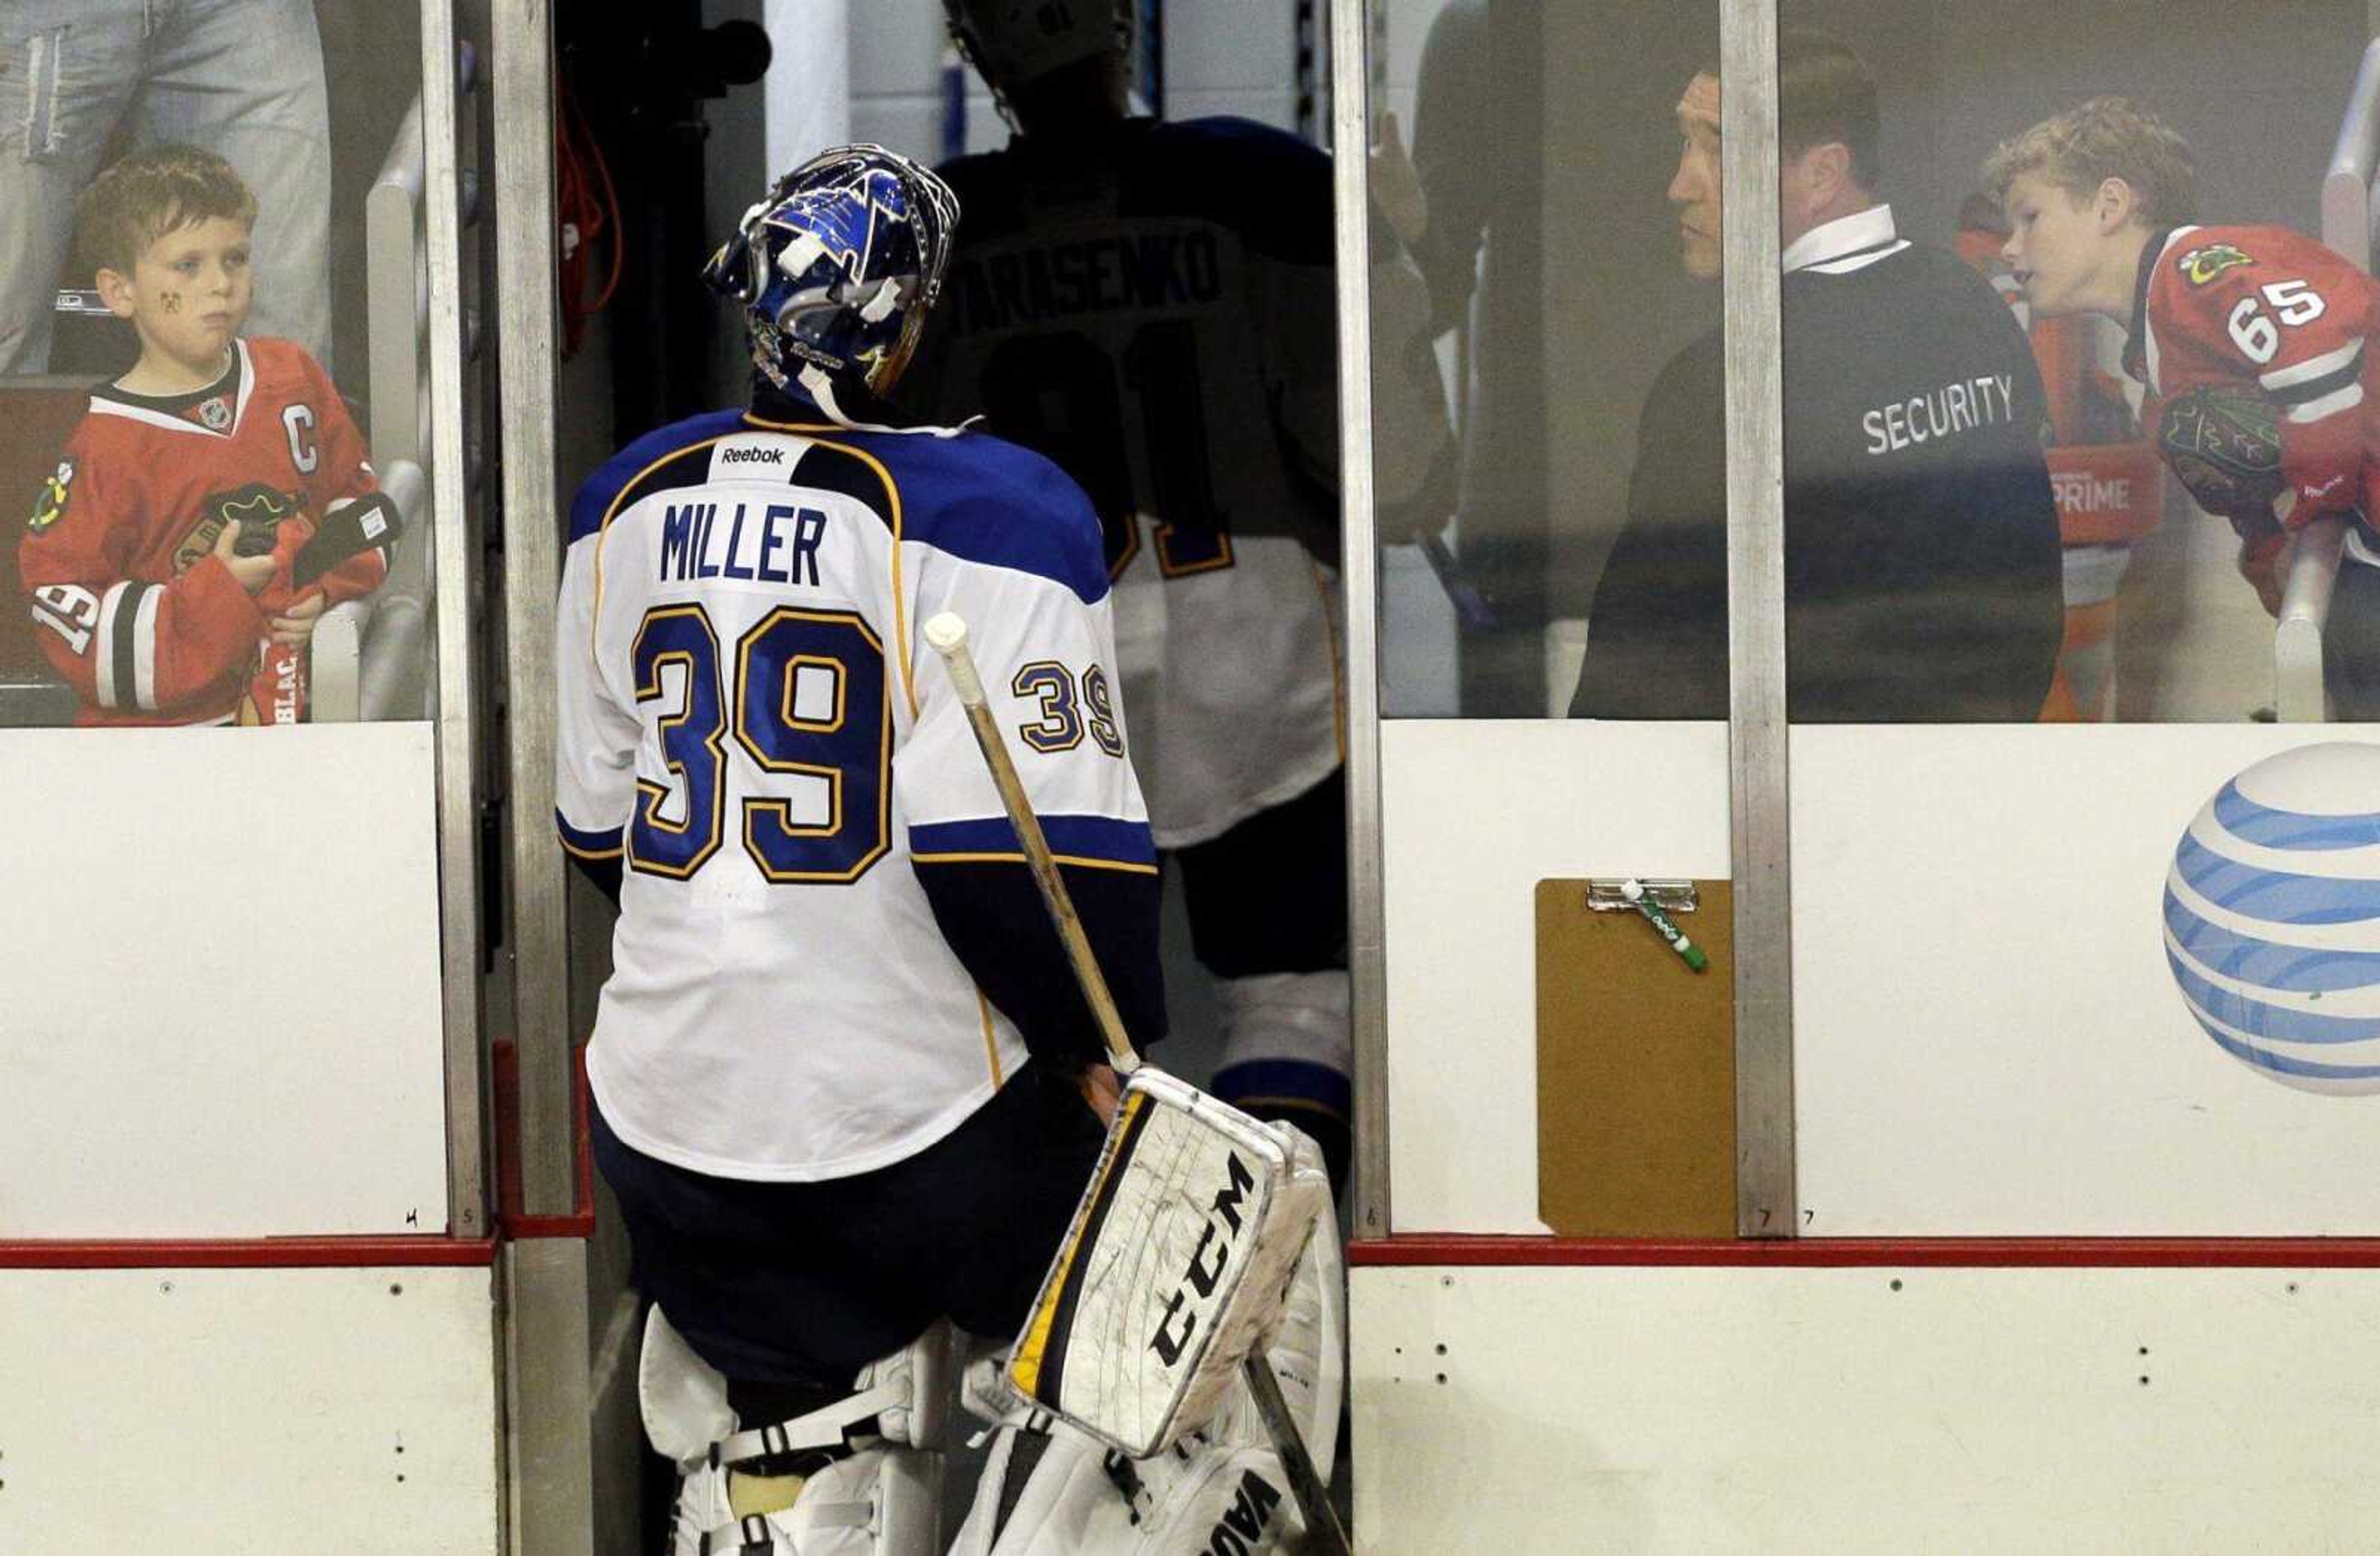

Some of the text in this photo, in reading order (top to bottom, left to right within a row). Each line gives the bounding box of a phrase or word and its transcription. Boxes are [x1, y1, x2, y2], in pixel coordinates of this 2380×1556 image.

[2226, 280, 2326, 366] 65
[280, 403, 319, 474] C
[721, 446, 785, 465] Reebok
[1862, 374, 2014, 456] SECURITY
[660, 503, 827, 586] MILLER
[30, 583, 101, 656] 19
[627, 601, 894, 885] 39
[1012, 660, 1125, 758] 39
[1148, 1149, 1254, 1367] CCM
[1758, 1208, 1771, 1227] 7
[1804, 1209, 1814, 1225] 7
[1199, 1467, 1282, 1556] VAU
